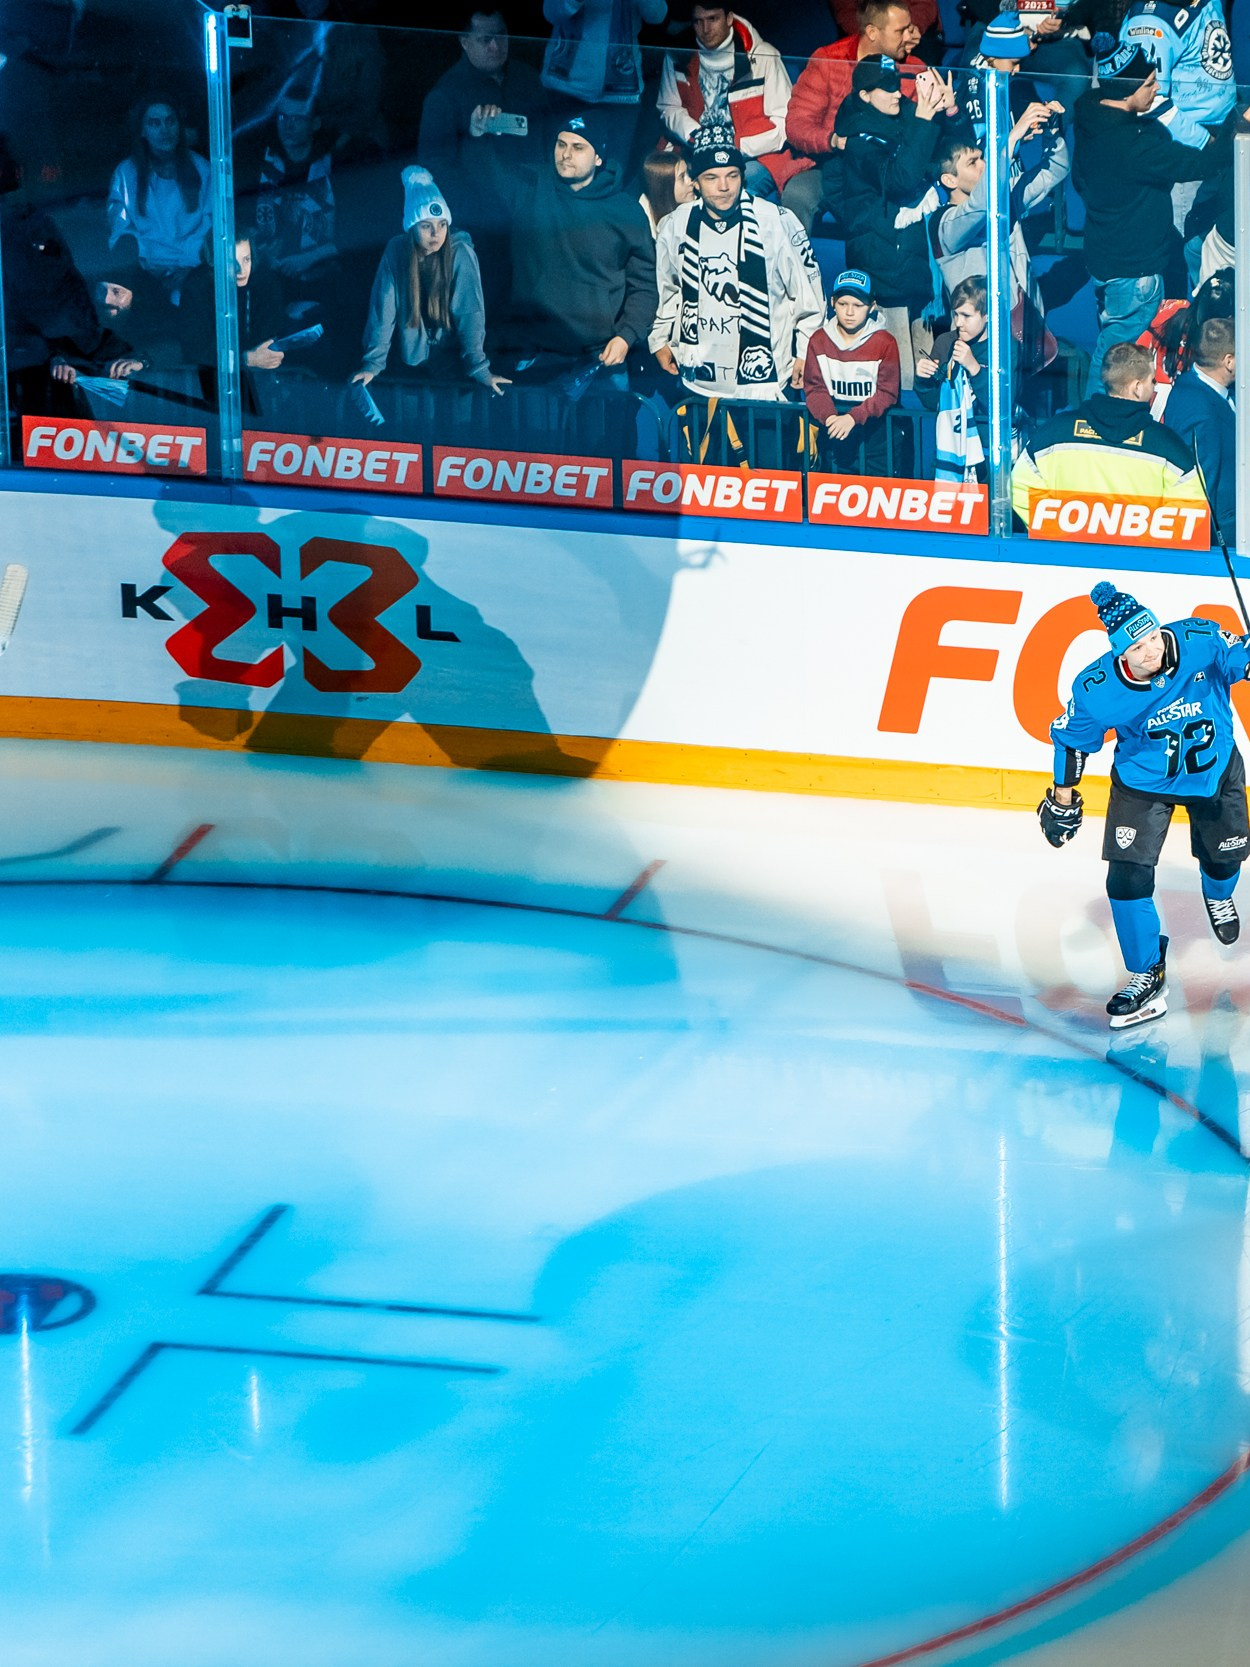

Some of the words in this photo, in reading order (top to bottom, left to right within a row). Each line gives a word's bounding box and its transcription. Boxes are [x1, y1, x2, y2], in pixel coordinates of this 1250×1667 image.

[27, 427, 202, 467] FONBET
[247, 441, 419, 483] FONBET
[437, 456, 609, 498] FONBET
[626, 471, 798, 512] FONBET
[811, 483, 984, 524] FONBET
[1032, 498, 1207, 541] FONBET
[1145, 717, 1219, 779] 72
